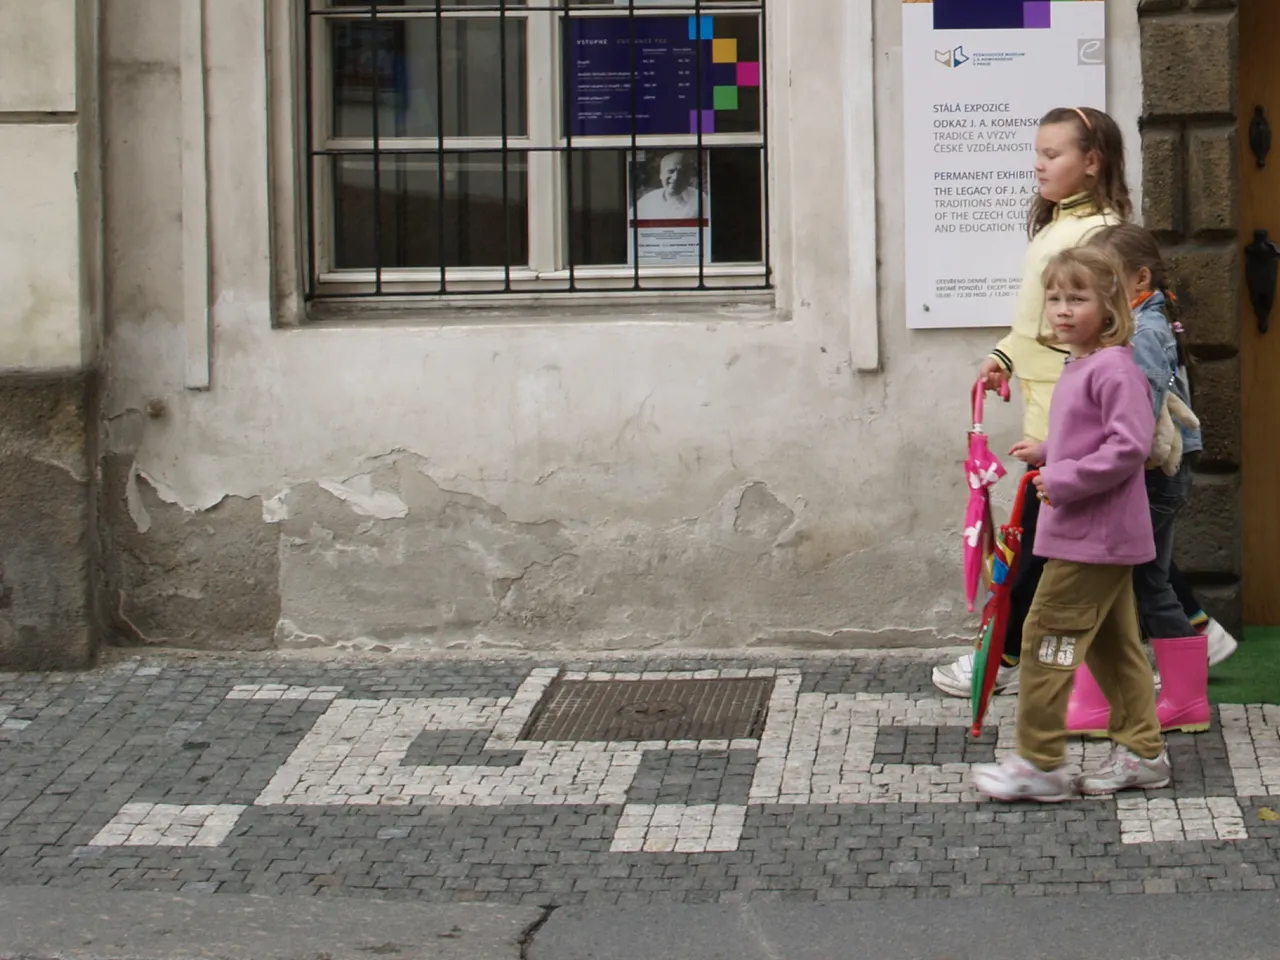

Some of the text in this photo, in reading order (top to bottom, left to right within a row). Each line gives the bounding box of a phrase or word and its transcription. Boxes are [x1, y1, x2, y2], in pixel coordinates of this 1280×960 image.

[933, 102, 1010, 113] STÁLÁ EXPOZICE
[933, 118, 1041, 128] ODKAZ J. A. KOMENSK
[933, 130, 1017, 141] TRADICE A VÝZVY
[933, 142, 1032, 153] ČESKÉ VZDĚLANOSTI
[934, 171, 993, 181] PERMANENT
[934, 187, 953, 196] THE
[956, 186, 992, 196] LEGACY
[995, 186, 1008, 195] OF
[1010, 186, 1017, 195] J.
[1020, 186, 1028, 195] A.
[934, 199, 992, 208] TRADITIONS
[995, 198, 1016, 208] AND
[935, 210, 1029, 221] OF THE CZECH CULT
[934, 224, 956, 233] AND
[959, 223, 1015, 233] EDUCATION
